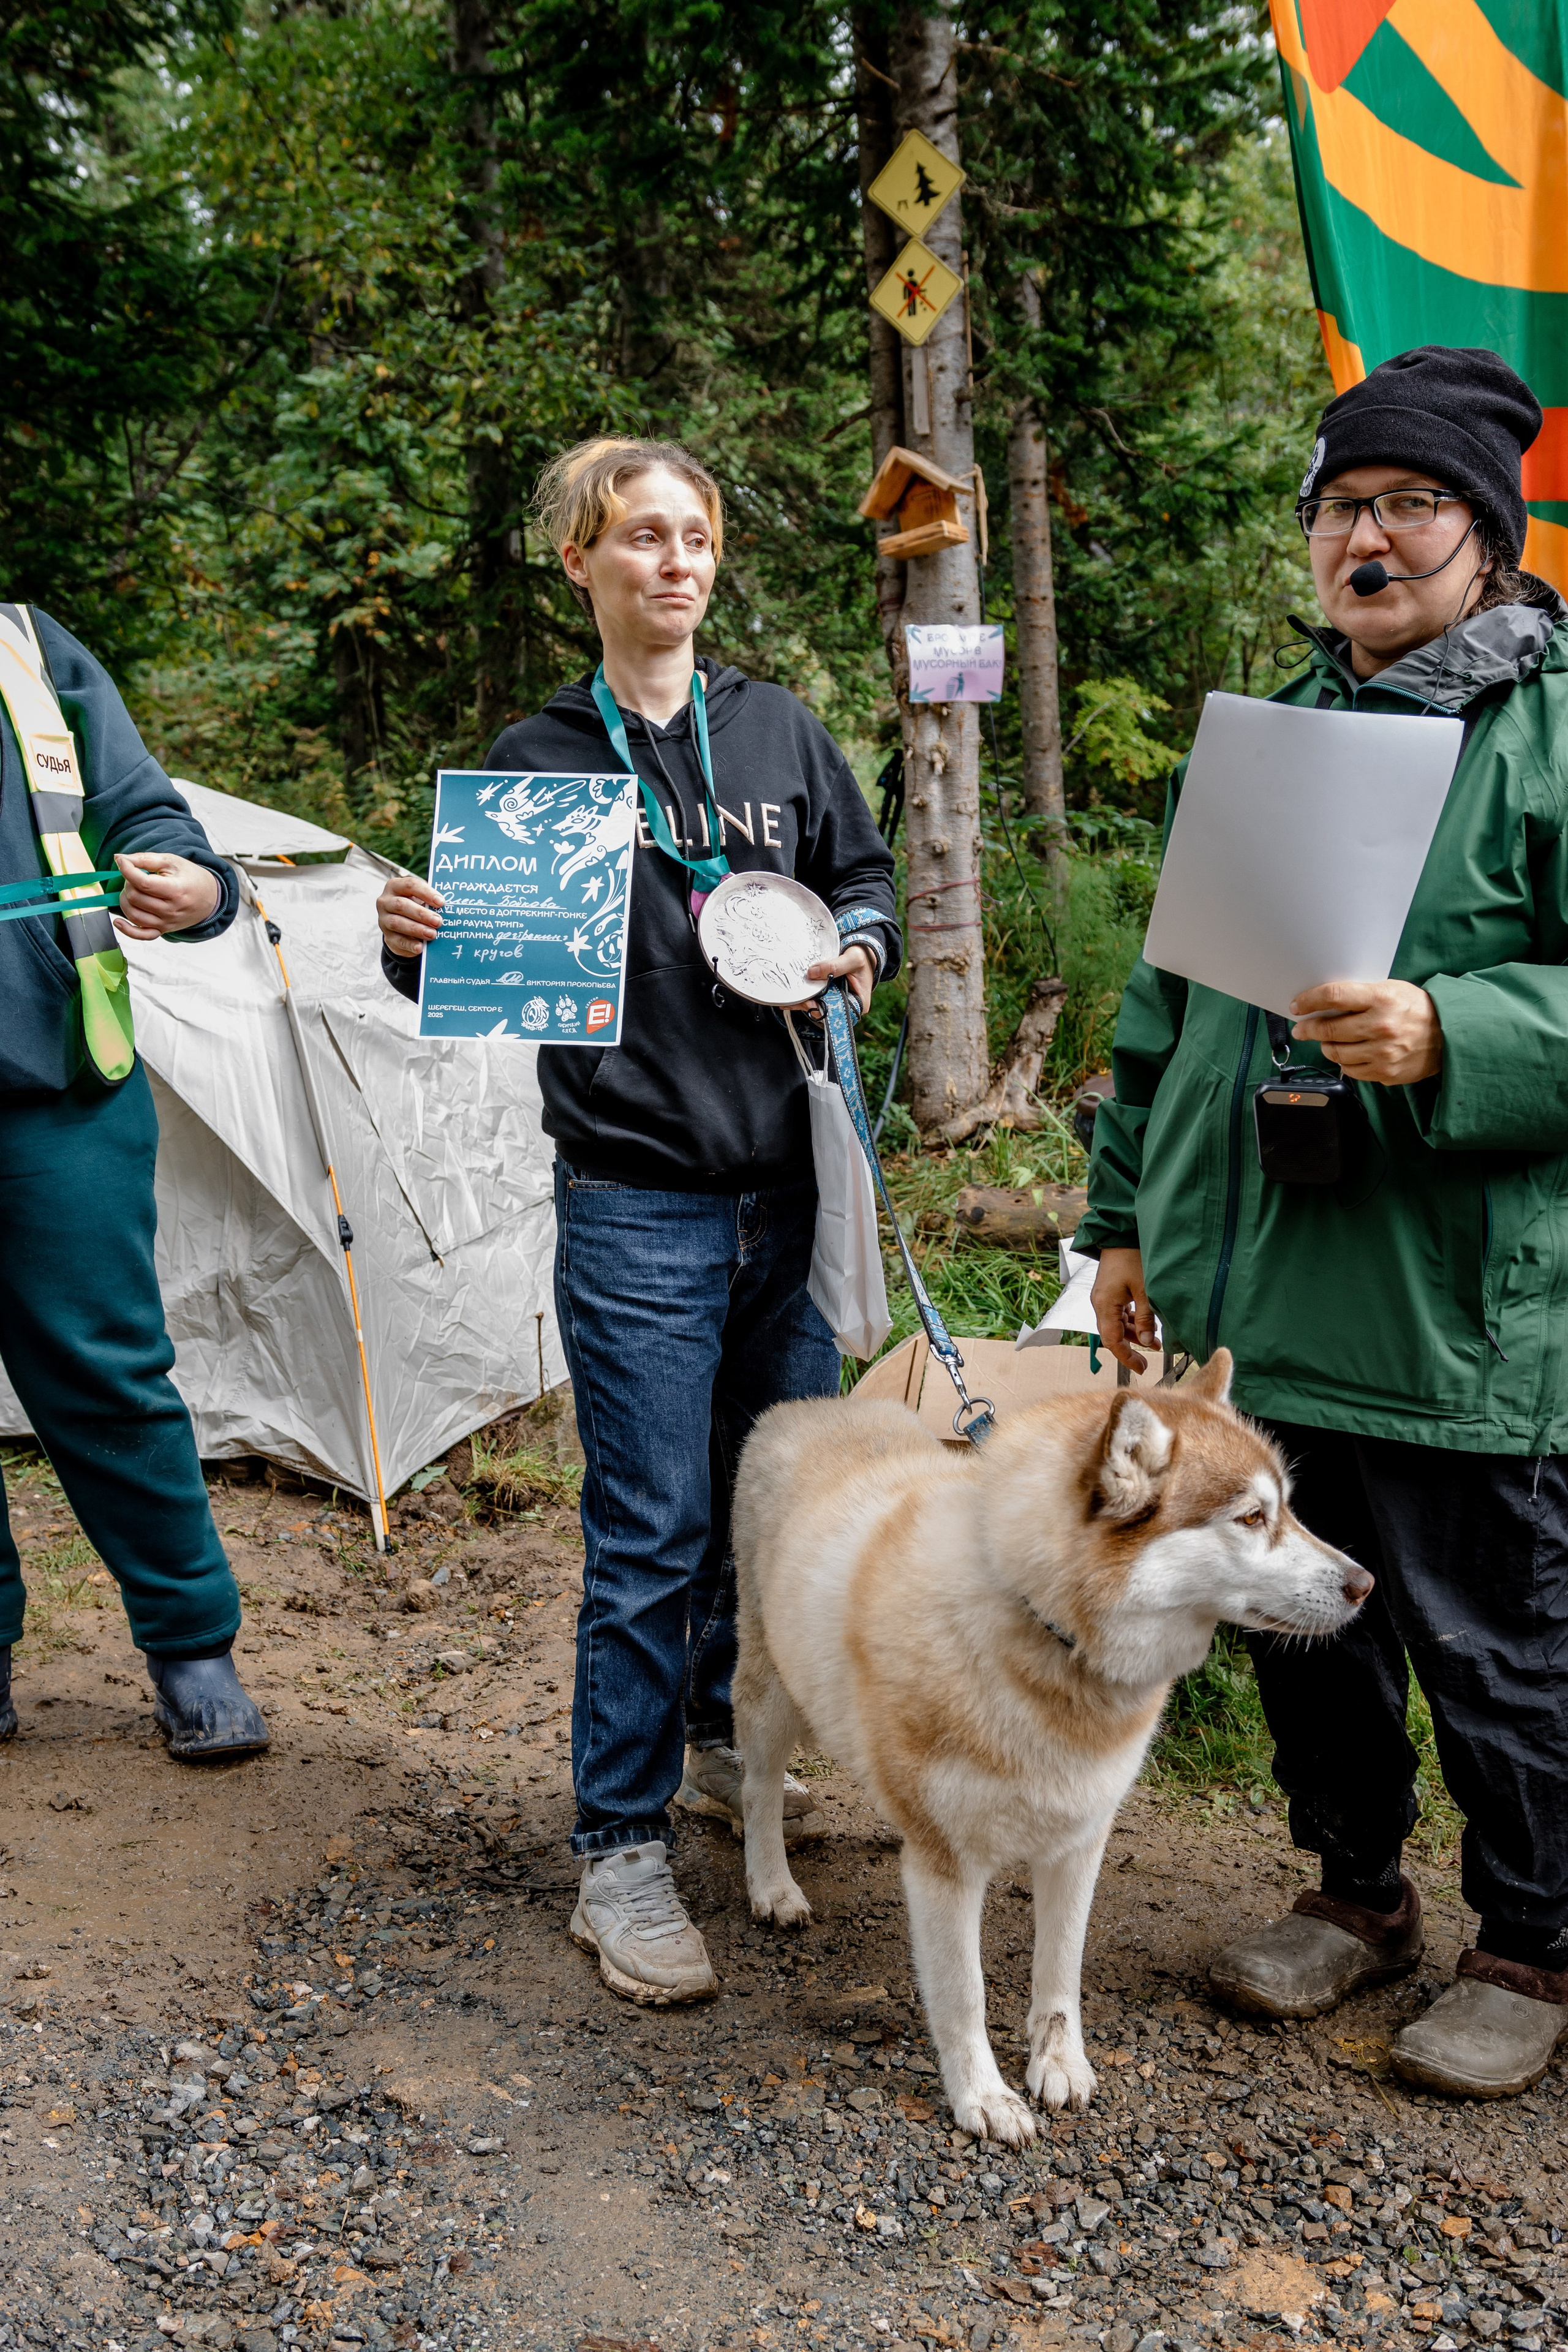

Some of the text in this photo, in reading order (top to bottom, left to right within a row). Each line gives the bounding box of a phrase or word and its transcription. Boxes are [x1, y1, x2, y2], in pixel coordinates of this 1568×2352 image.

[974, 646, 982, 655] В
[913, 657, 977, 671] МУСОРНЫЙ
[36, 753, 72, 774] СУДЬЯ
[435, 853, 538, 876] ДИПЛОМ
[434, 881, 539, 894] НАГРАЖДАЕТСЯ
[456, 907, 488, 916] МЕСТО
[496, 909, 588, 919] ДОГТРЕКИНГ-ГОНКЕ
[463, 919, 494, 929] РАУНД
[451, 944, 524, 963] 7 кругов
[429, 976, 466, 984] ГЛАВНЫЙ
